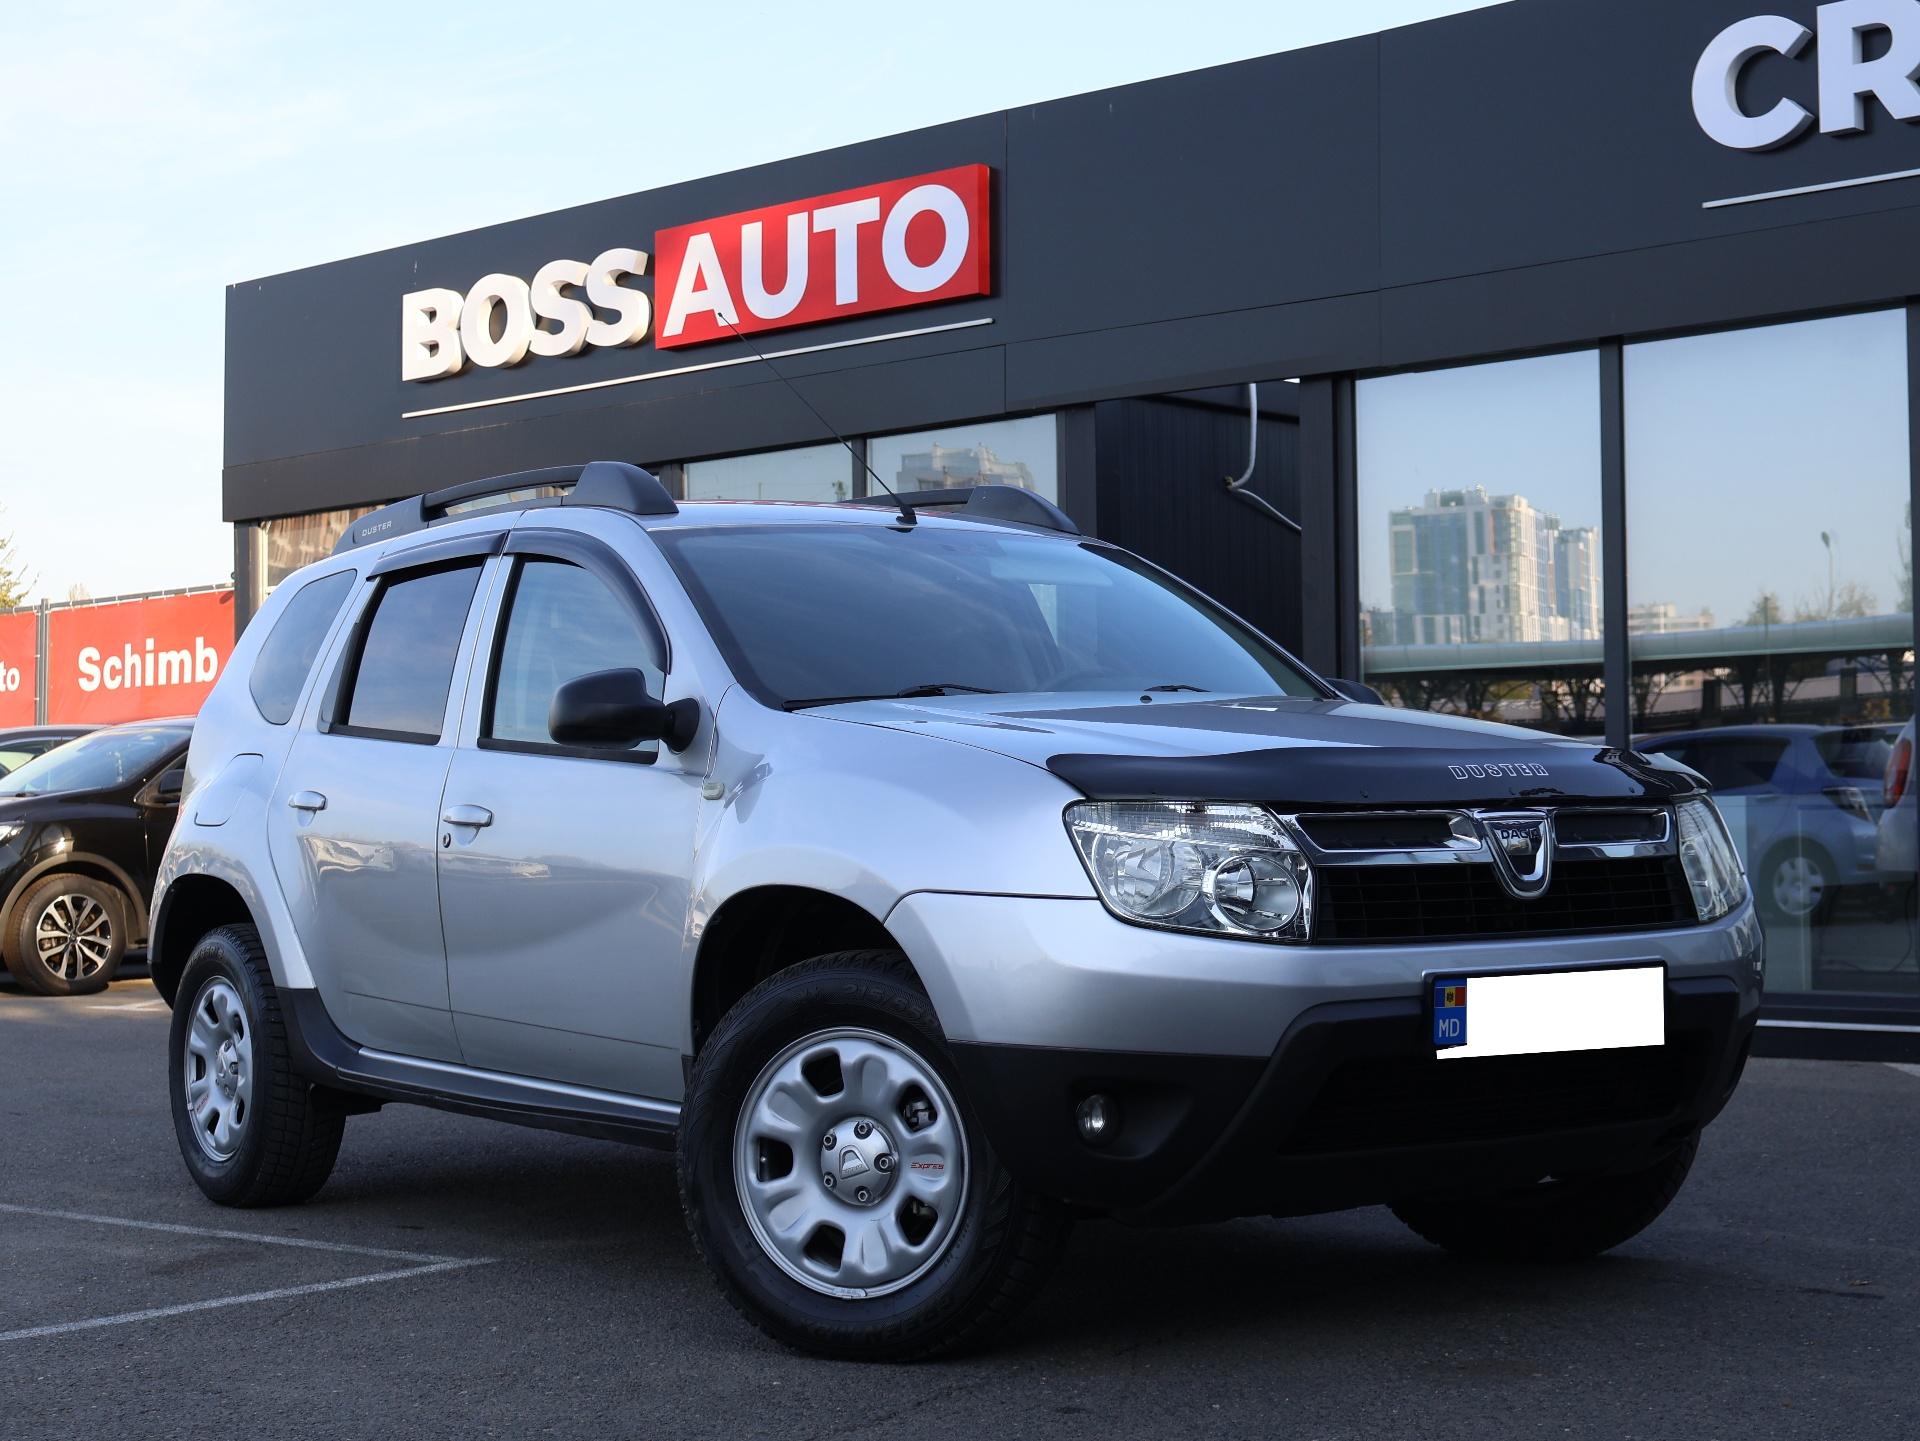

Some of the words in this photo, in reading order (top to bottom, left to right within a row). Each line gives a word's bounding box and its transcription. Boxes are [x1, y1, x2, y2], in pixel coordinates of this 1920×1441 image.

[1691, 0, 1920, 151] CR
[402, 247, 653, 381] BOSS
[662, 184, 970, 337] AUTO
[361, 520, 392, 537] DUSTER
[77, 636, 219, 692] Schimb
[1448, 763, 1549, 780] DUSTER
[1438, 1018, 1460, 1038] MD
